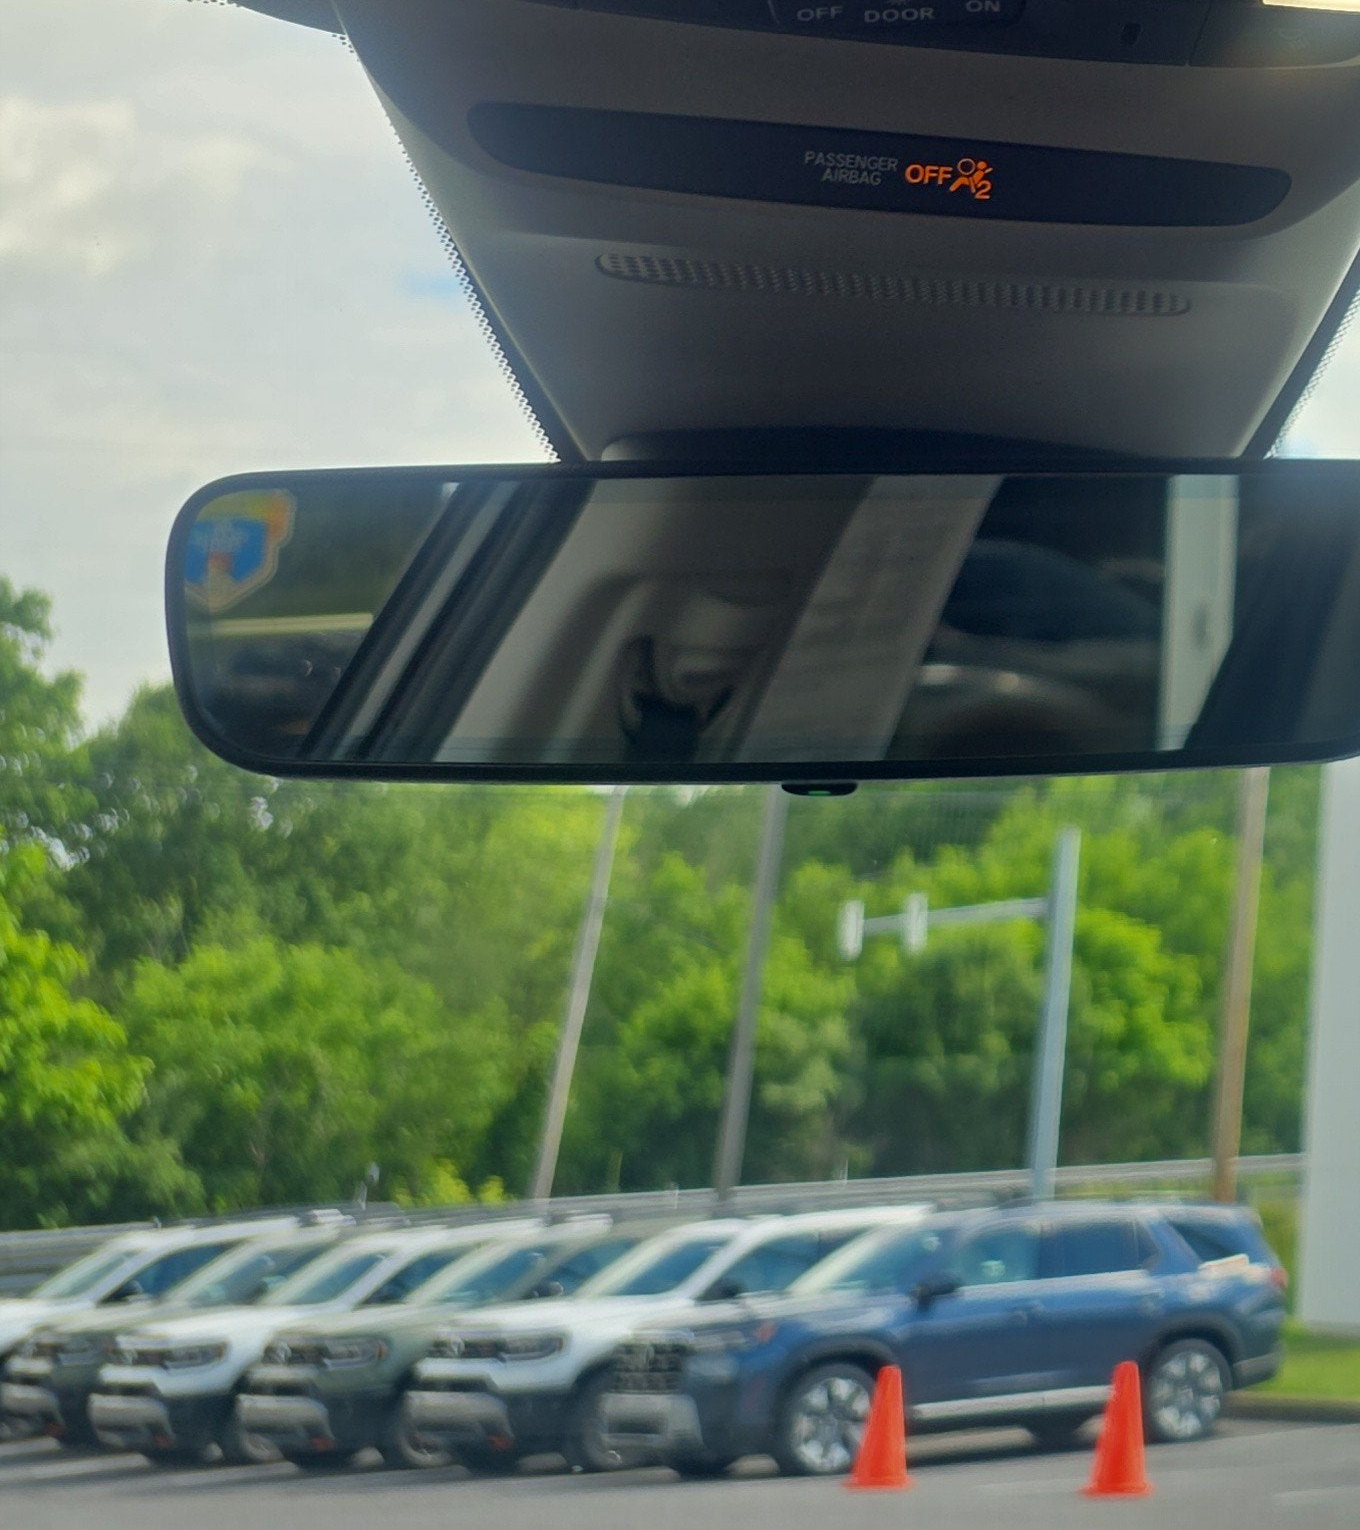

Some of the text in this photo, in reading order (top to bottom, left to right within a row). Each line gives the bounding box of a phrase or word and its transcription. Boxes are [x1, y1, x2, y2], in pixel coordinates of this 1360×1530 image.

[797, 0, 1000, 23] OFF DOOR ON
[805, 150, 898, 171] PASSENGER
[822, 168, 882, 186] AIRBAG
[904, 164, 952, 184] OFF
